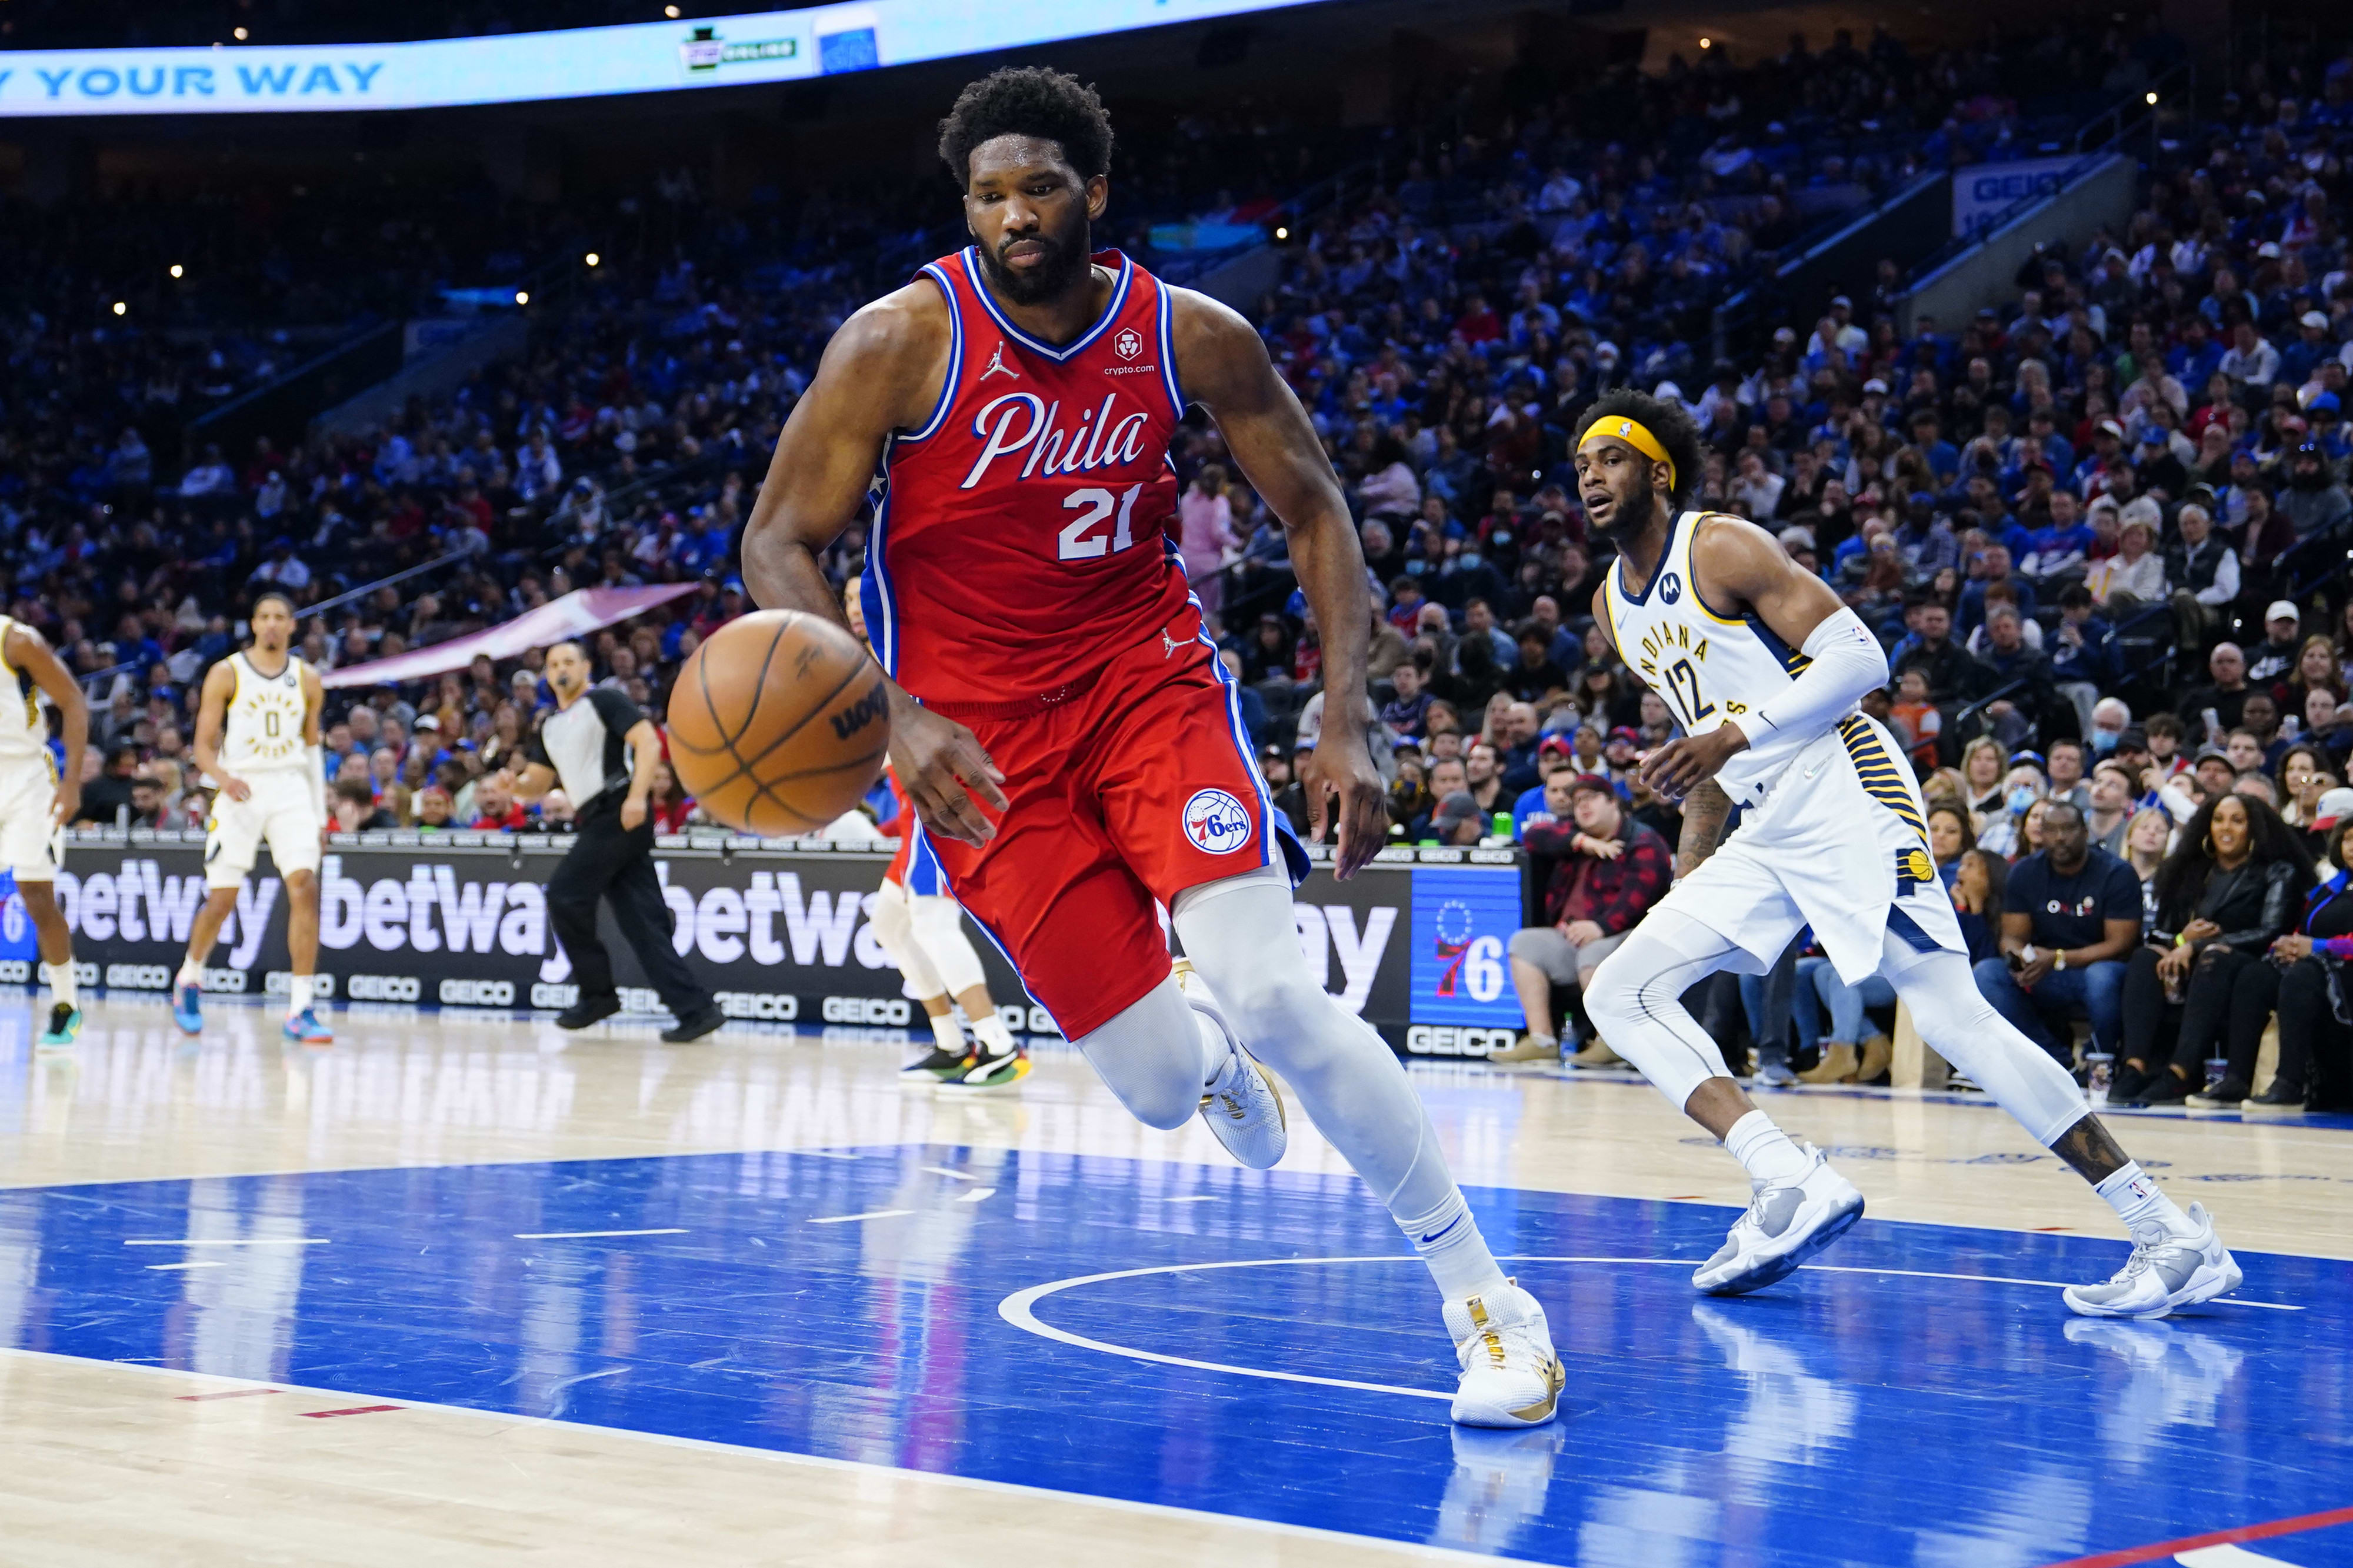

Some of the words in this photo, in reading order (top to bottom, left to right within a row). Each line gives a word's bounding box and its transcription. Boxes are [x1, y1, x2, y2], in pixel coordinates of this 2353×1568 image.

[36, 66, 215, 98] YOUR
[235, 62, 385, 95] WAY
[1104, 365, 1155, 376] crypto.com
[958, 392, 1148, 490] Phila
[1058, 483, 1144, 561] 21
[1641, 620, 1709, 690] INDIANA
[266, 710, 279, 738] 0
[1664, 658, 1717, 728] 12
[1190, 814, 1247, 843] 76ers
[0, 892, 26, 943] 6
[319, 855, 572, 983] betwa
[106, 963, 171, 989] GEICO
[348, 975, 421, 1002] GEICO
[439, 979, 515, 1006] GEICO
[822, 996, 911, 1026] GEICO
[1435, 935, 1505, 1003] 76
[1407, 1025, 1517, 1058] GEICO
